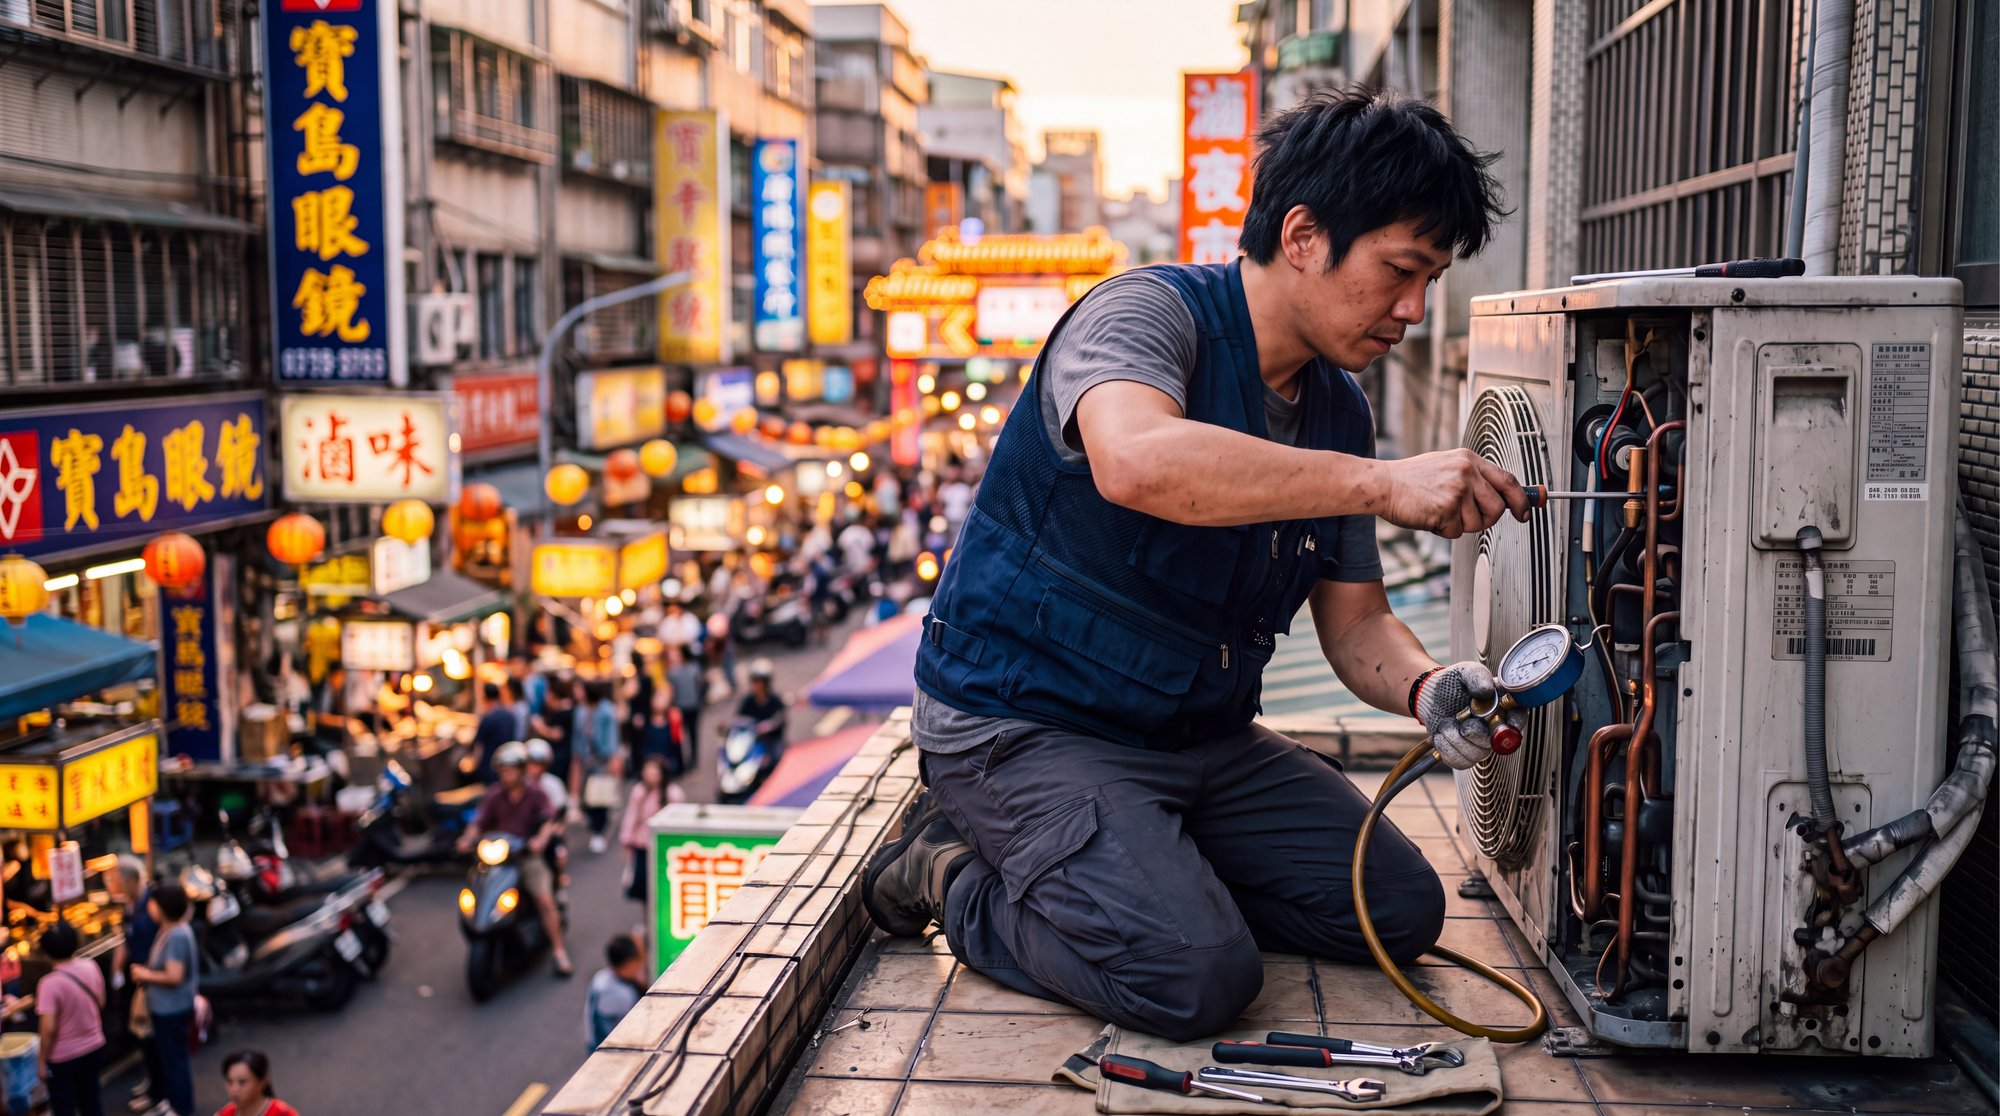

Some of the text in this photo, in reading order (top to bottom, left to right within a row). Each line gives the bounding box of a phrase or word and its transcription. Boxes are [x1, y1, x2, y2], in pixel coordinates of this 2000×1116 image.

[289, 19, 371, 343] 寶島眼鏡
[50, 413, 264, 532] 寶島眼鏡
[298, 413, 434, 487] 滷味
[667, 841, 774, 940] 龍
